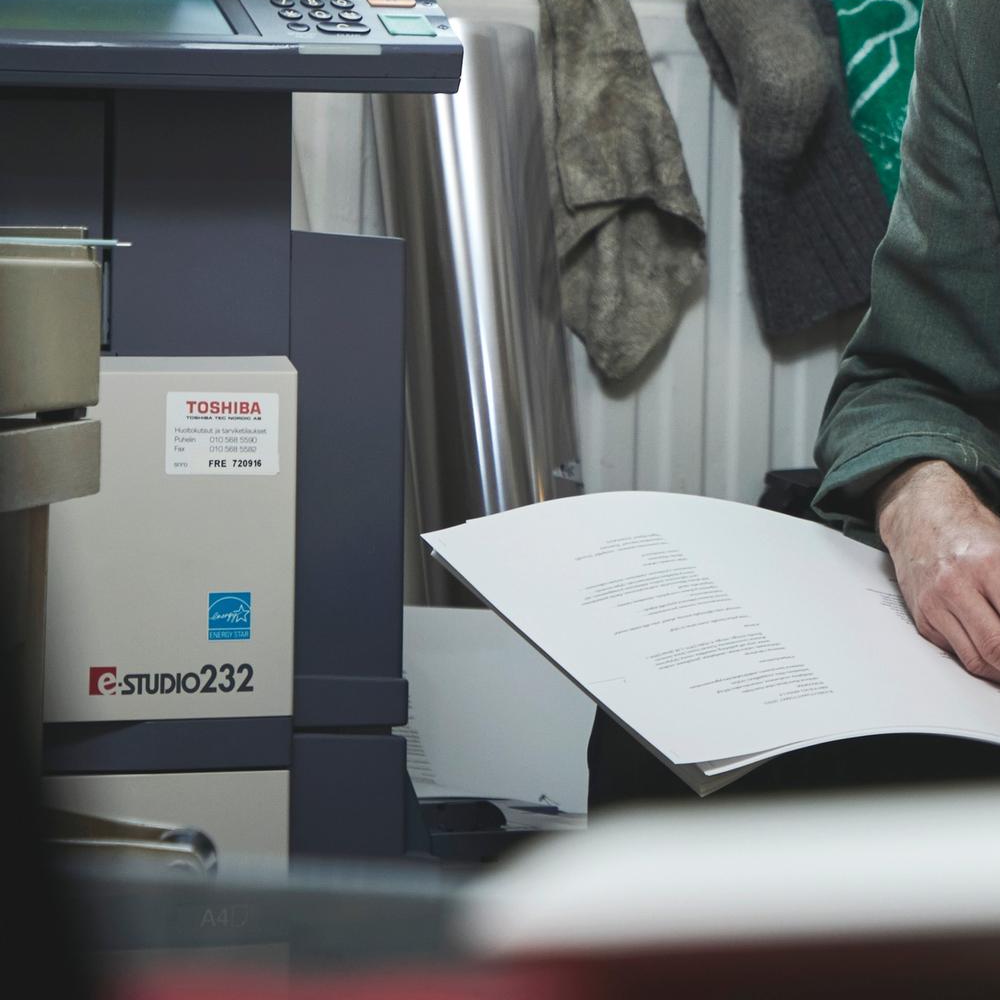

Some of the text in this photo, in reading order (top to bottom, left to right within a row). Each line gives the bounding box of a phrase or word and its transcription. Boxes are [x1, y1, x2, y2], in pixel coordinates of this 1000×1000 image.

[186, 400, 262, 415] TOSHIBA
[209, 436, 223, 444] 010
[209, 445, 223, 453] 010
[208, 459, 227, 468] FRE
[232, 459, 262, 468] 720916
[209, 629, 249, 639] ENERGY STAR
[200, 908, 229, 928] A4
